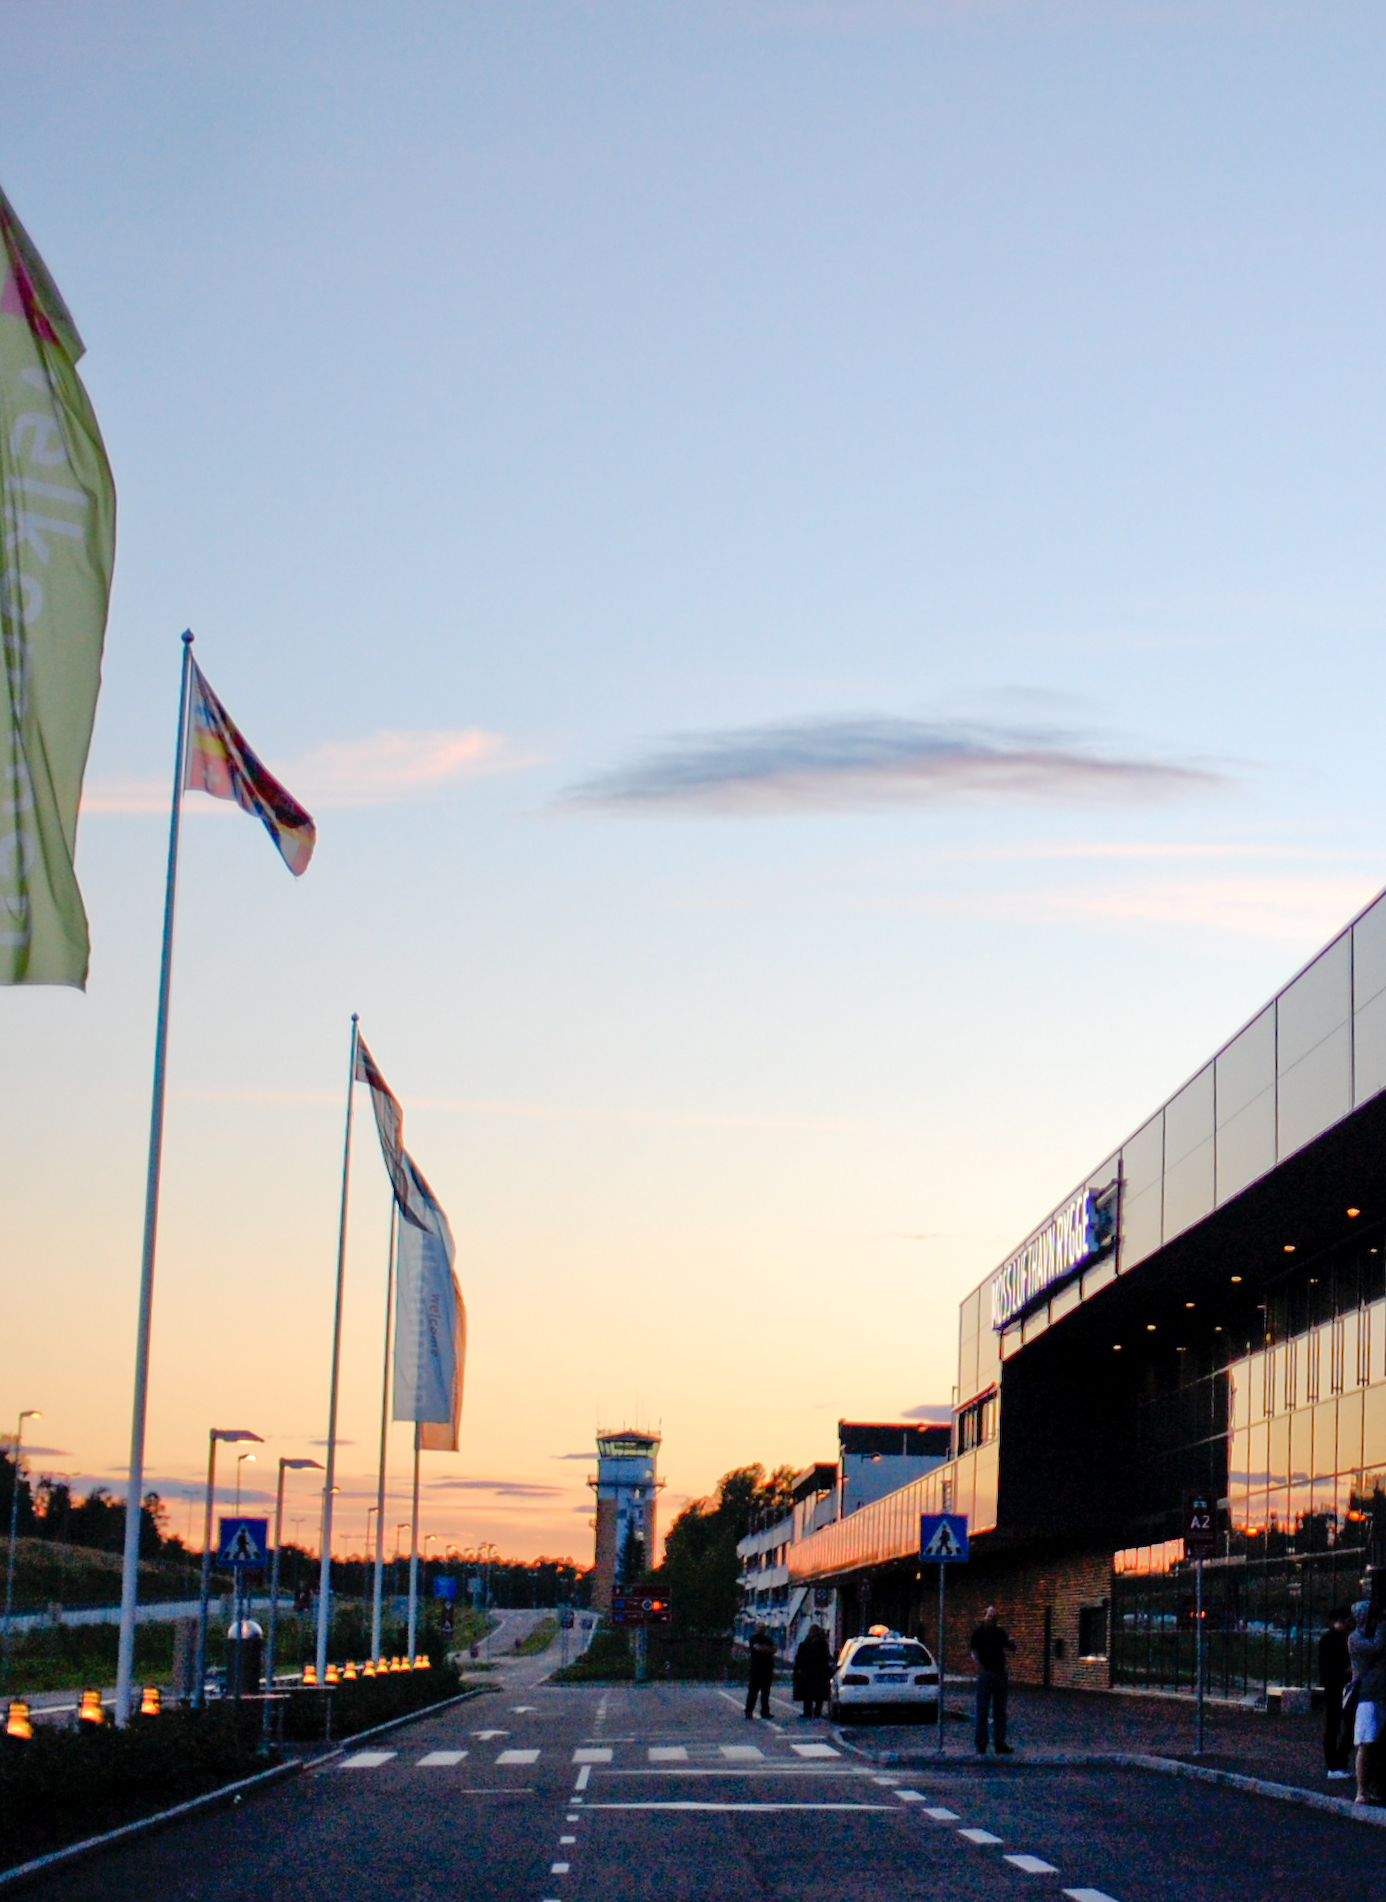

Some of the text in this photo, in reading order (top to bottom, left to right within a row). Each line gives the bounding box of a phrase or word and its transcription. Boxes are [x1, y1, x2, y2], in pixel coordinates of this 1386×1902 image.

[1056, 1190, 1089, 1275] RYGGE
[430, 1293, 442, 1358] welcome
[1190, 1514, 1210, 1529] A2
